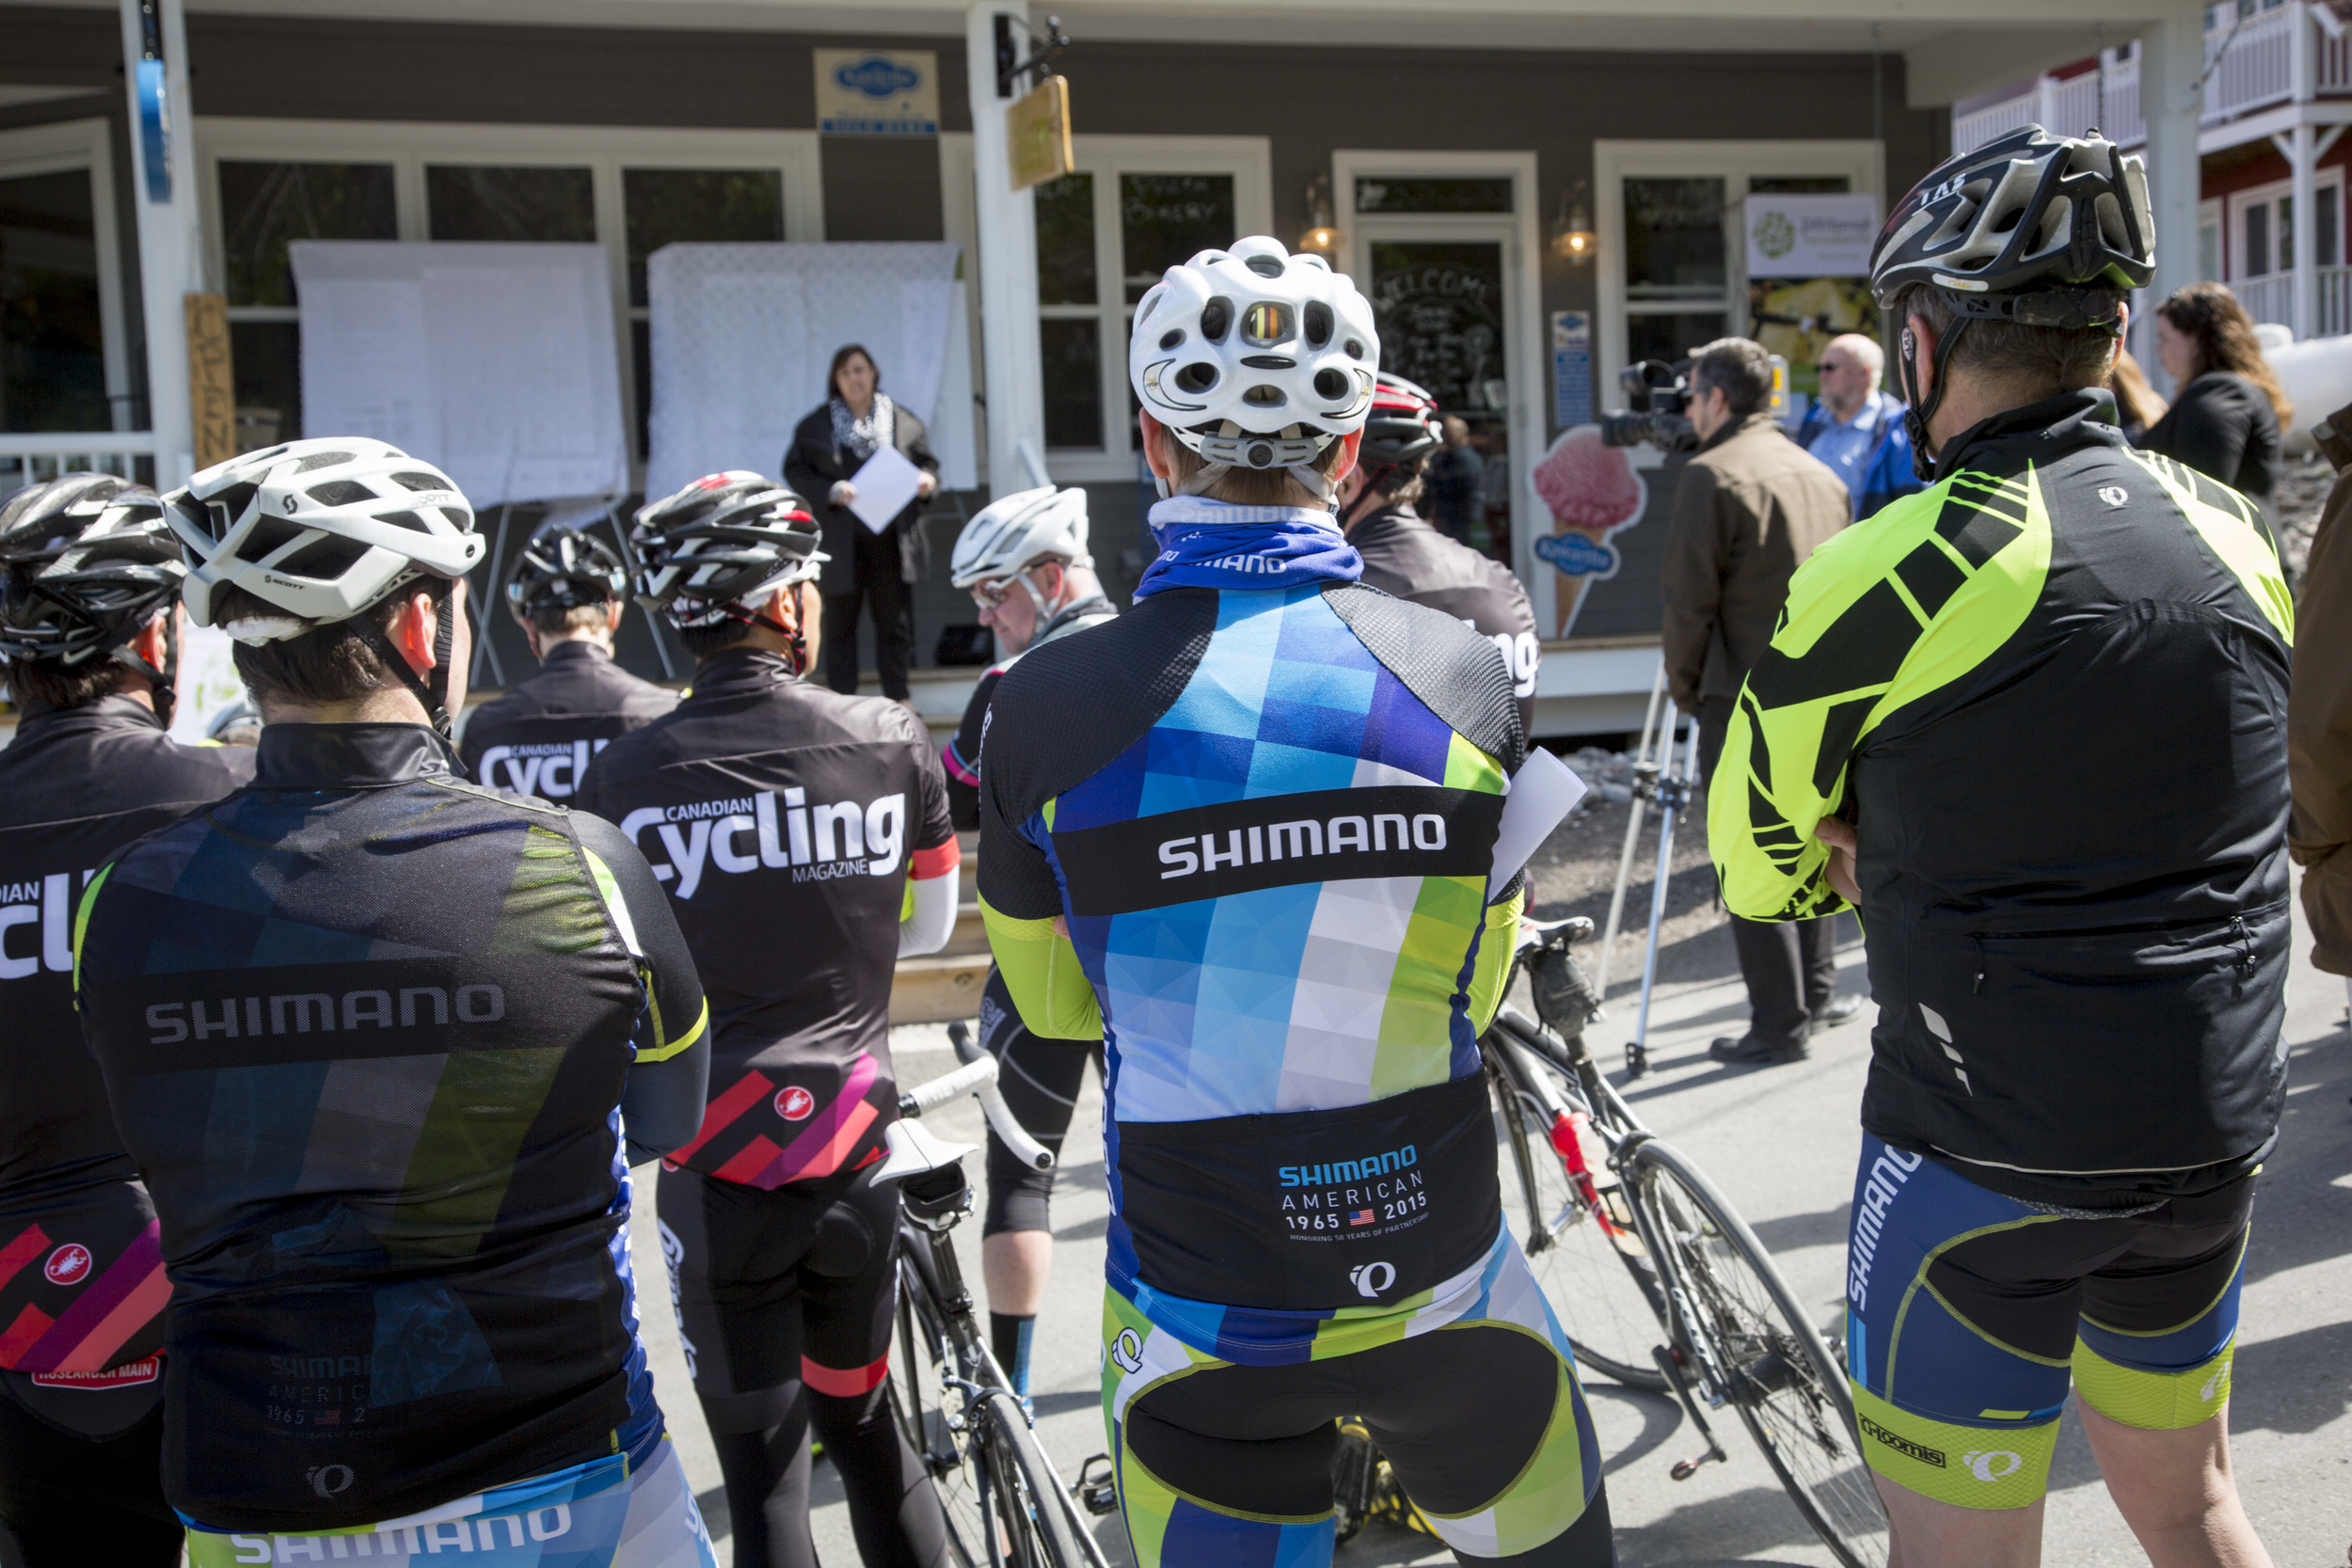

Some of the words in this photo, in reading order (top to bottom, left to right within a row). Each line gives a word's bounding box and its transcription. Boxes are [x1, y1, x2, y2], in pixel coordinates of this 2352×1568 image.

[193, 305, 228, 459] OPEN
[272, 578, 306, 590] SCOTT
[479, 738, 610, 798] Cycl
[511, 743, 573, 757] CANADIAN
[666, 797, 753, 822] CANADIAN
[620, 786, 905, 900] Cycling
[1158, 813, 1447, 879] SHIMANO
[792, 858, 869, 884] MAGAZINE
[146, 984, 506, 1044] SHIMANO
[1279, 1144, 1417, 1187] SHIMANO
[1281, 1170, 1422, 1211] AMERICAN
[1285, 1213, 1340, 1230] 1965
[1384, 1191, 1427, 1220] 2015
[1290, 1233, 1332, 1242] HONORING
[1346, 1230, 1372, 1240] YEARS
[1373, 1228, 1383, 1237] OF
[1385, 1212, 1429, 1234] PARTNERSHIP
[1849, 1144, 1923, 1312] SHIMANO
[119, 1363, 151, 1377] MAIN
[230, 1503, 572, 1564] SHIMANO
